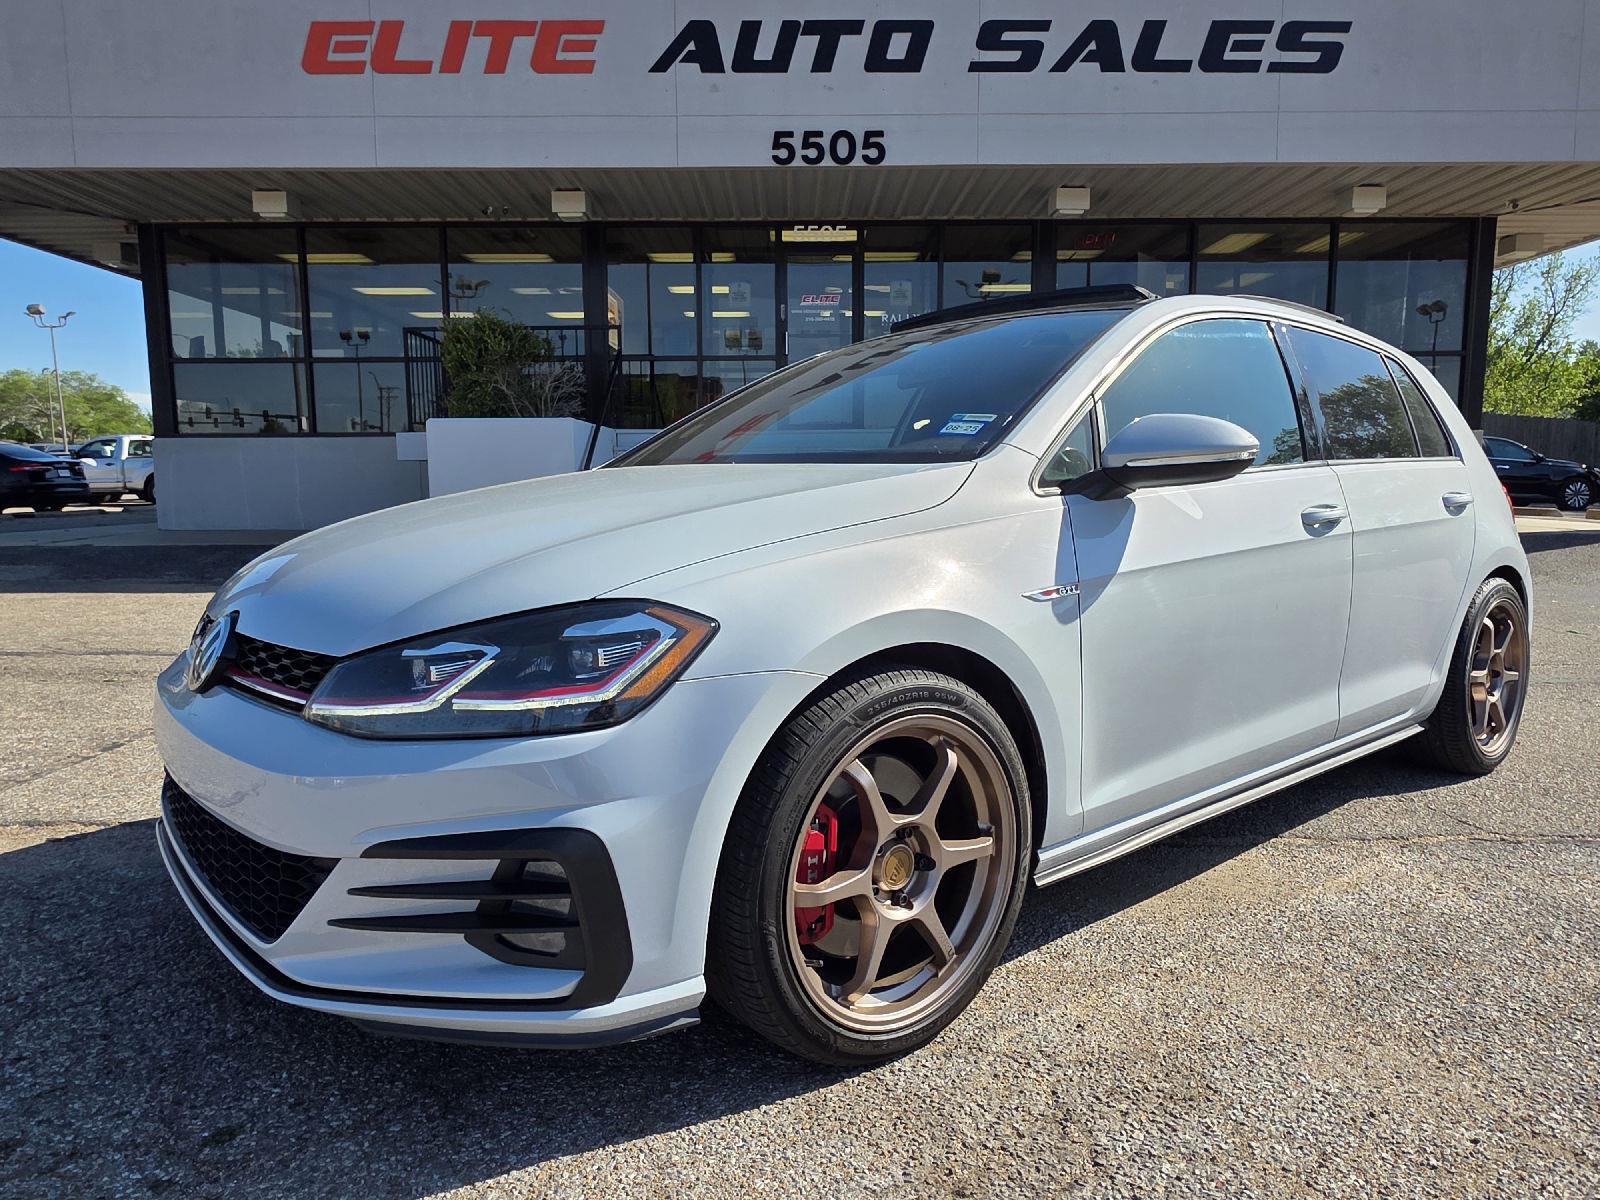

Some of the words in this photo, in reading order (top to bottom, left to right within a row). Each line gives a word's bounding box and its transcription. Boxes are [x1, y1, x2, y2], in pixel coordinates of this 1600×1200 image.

[302, 20, 605, 74] ELITE
[649, 19, 935, 73] AUTO
[968, 19, 1353, 73] SALES
[771, 129, 886, 165] 5505
[802, 294, 840, 303] ELITE
[1059, 585, 1076, 596] GTI
[934, 691, 957, 702] 95W
